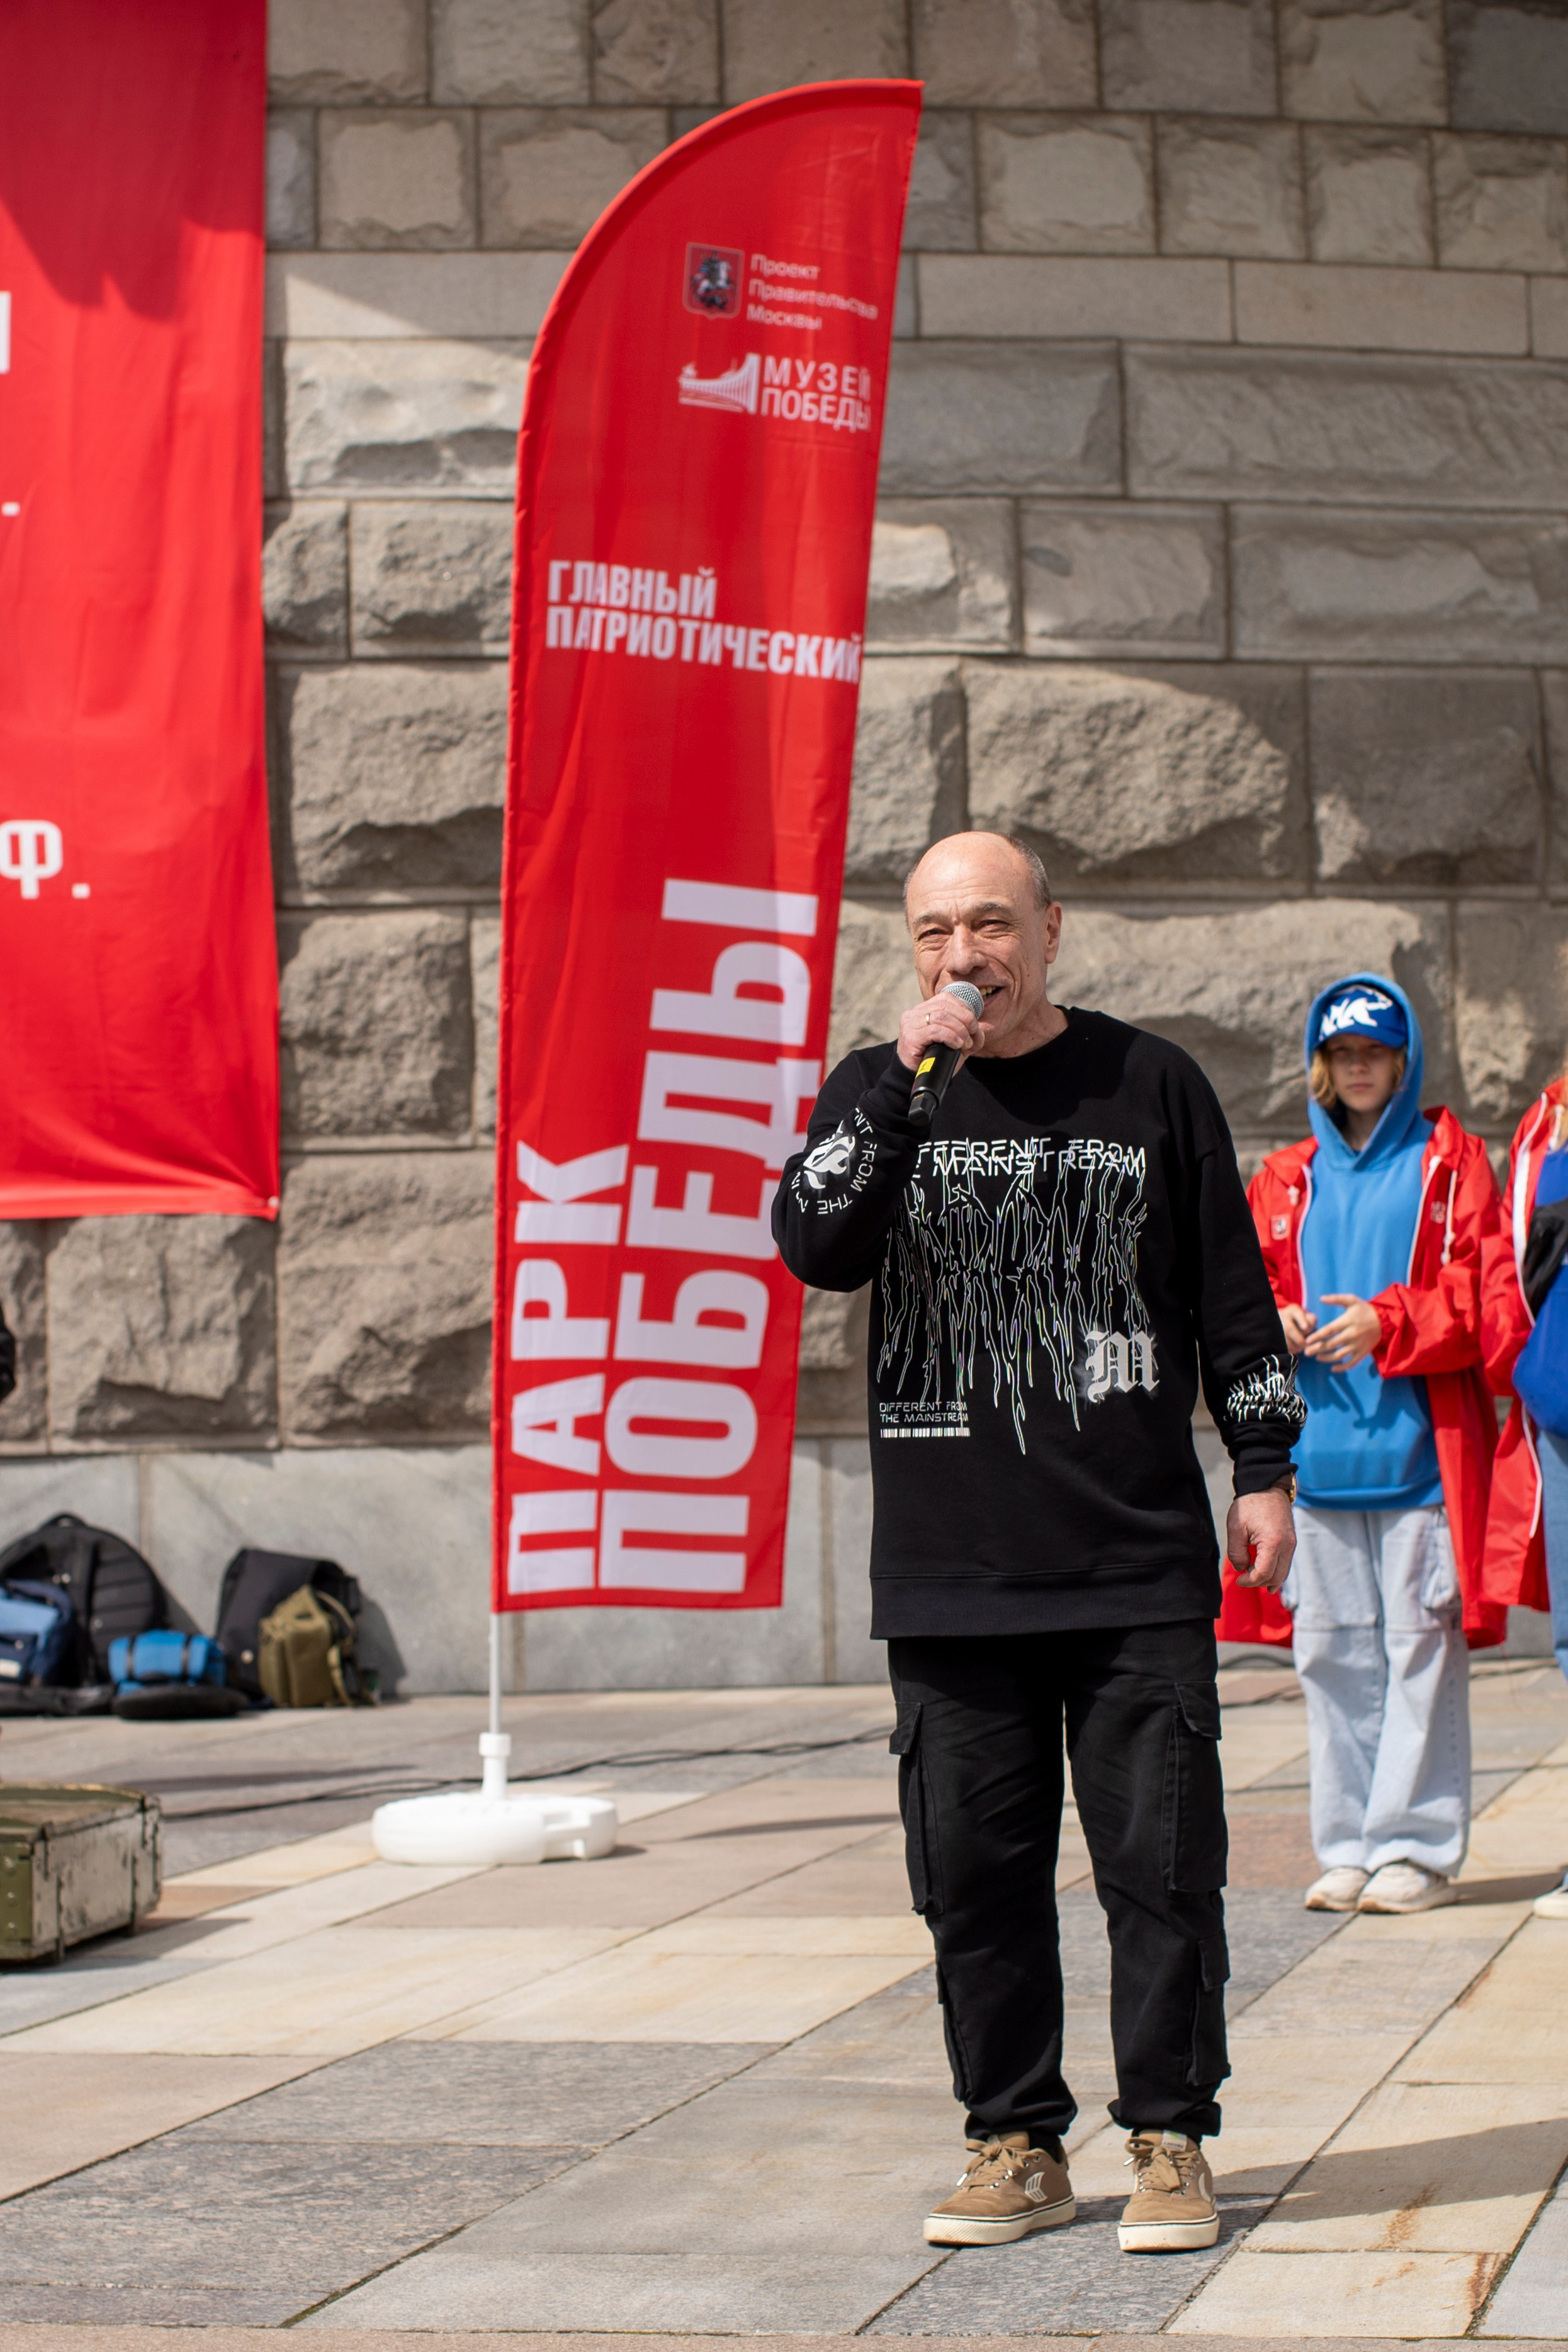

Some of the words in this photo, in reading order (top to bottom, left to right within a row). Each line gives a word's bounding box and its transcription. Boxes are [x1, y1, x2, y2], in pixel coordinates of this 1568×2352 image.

[751, 254, 820, 280] Проект
[747, 303, 823, 329] Москвы
[760, 388, 871, 433] ПОБЕДЫ
[547, 560, 718, 619] ГЛАВНЫЙ
[546, 606, 862, 684] ПАТРИОТИЧЕСКИЙ
[850, 1141, 877, 1192] FROM
[817, 1194, 853, 1214] THE
[599, 878, 822, 1595] ПОБЕДЫ
[507, 1140, 629, 1595] ПАРК
[879, 1402, 942, 1412] DIFFERENT
[946, 1401, 967, 1411] FROM
[880, 1413, 900, 1423] THE
[904, 1413, 969, 1423] MAINSTREAM
